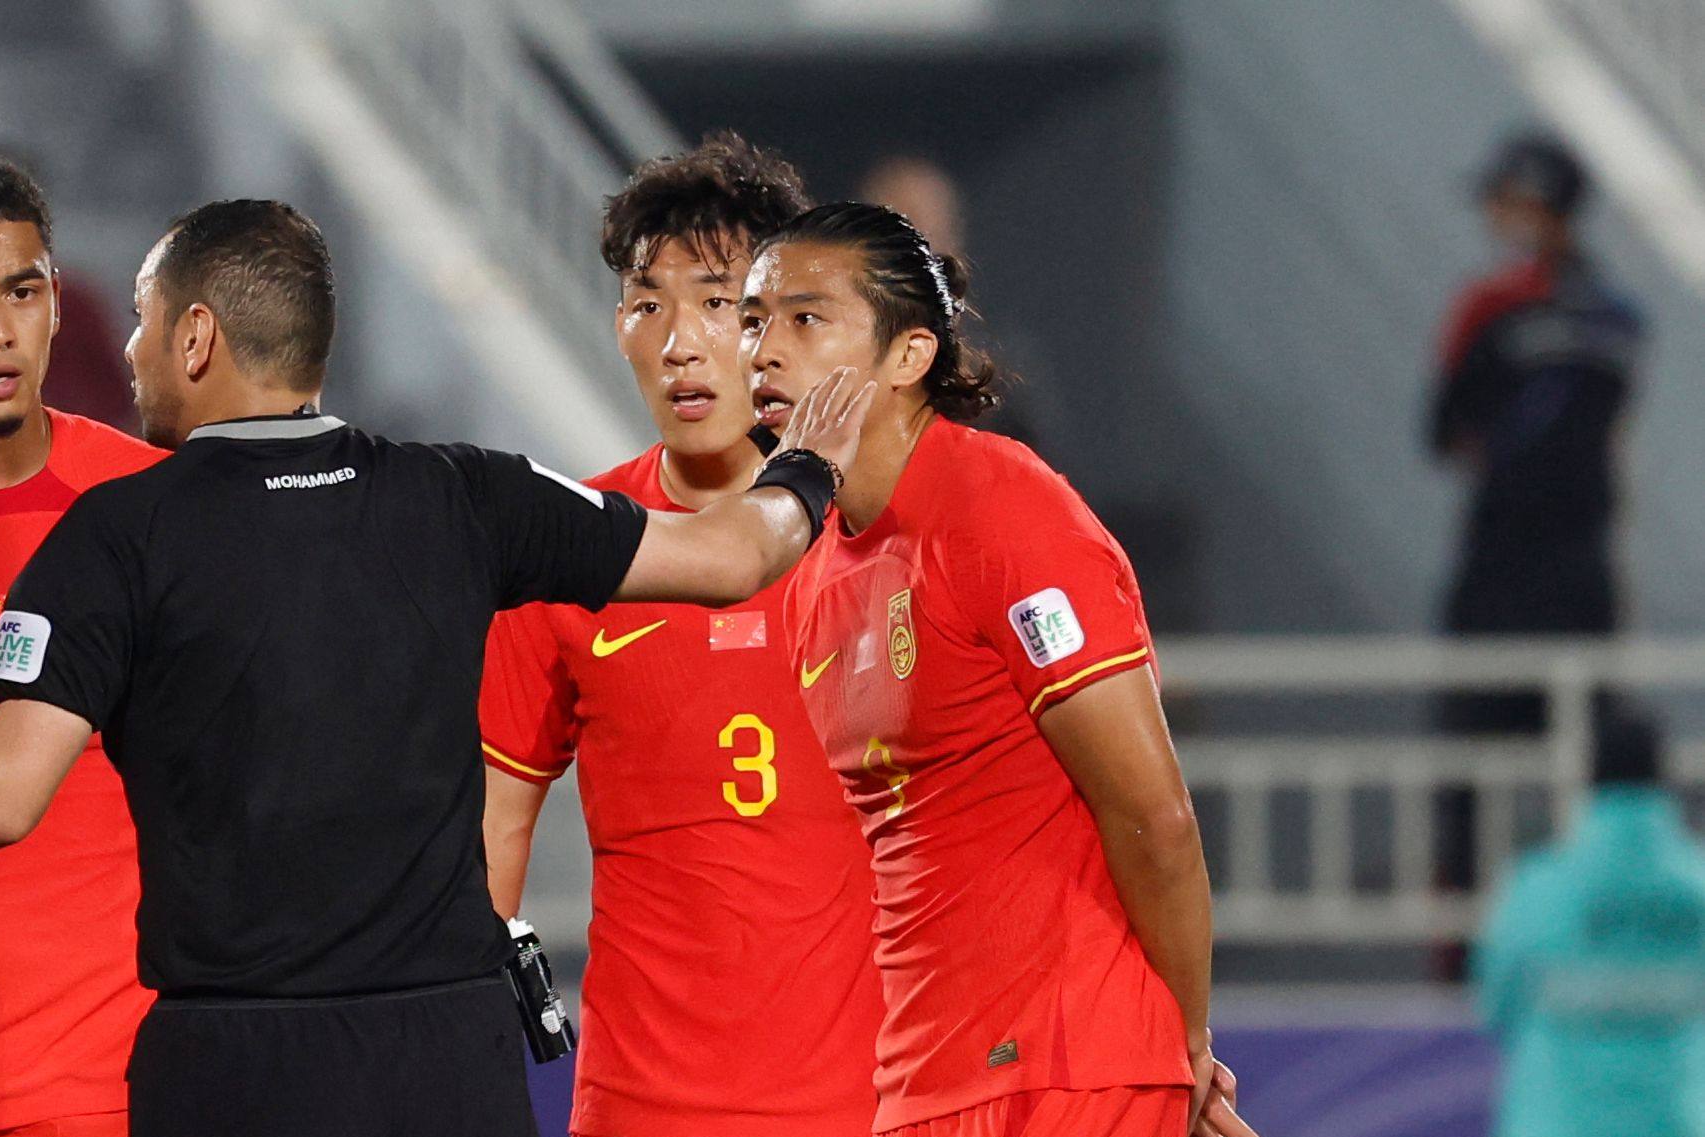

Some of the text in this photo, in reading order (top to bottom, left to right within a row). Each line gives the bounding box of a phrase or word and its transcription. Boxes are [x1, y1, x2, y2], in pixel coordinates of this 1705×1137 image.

[264, 466, 356, 490] MOHAMMED
[0, 621, 21, 633] AFC
[1019, 606, 1043, 625] AFC
[1023, 609, 1067, 641] LIVE
[718, 713, 777, 817] 3
